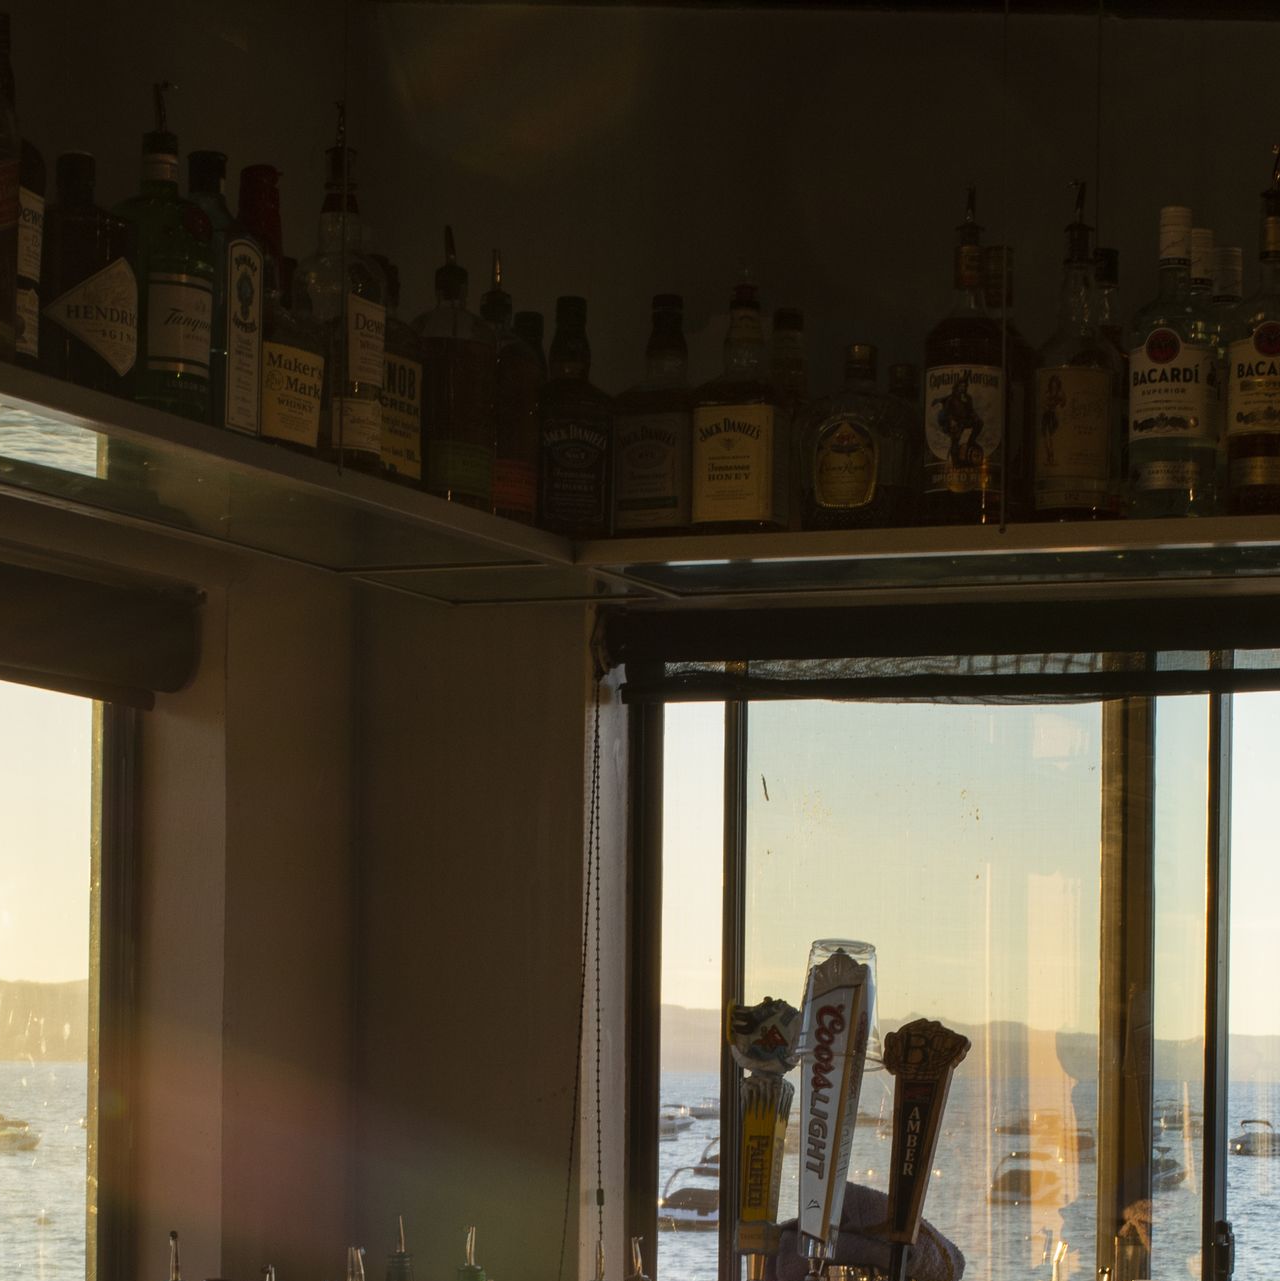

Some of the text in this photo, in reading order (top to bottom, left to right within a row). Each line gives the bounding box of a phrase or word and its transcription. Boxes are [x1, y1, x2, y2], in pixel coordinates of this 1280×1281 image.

[285, 375, 321, 399] Mark
[1133, 364, 1199, 387] BACARDÍ
[699, 423, 722, 442] JACK
[708, 472, 751, 482] HONEY
[805, 1003, 846, 1181] Coors LIGHT
[902, 1105, 921, 1176] AMBER
